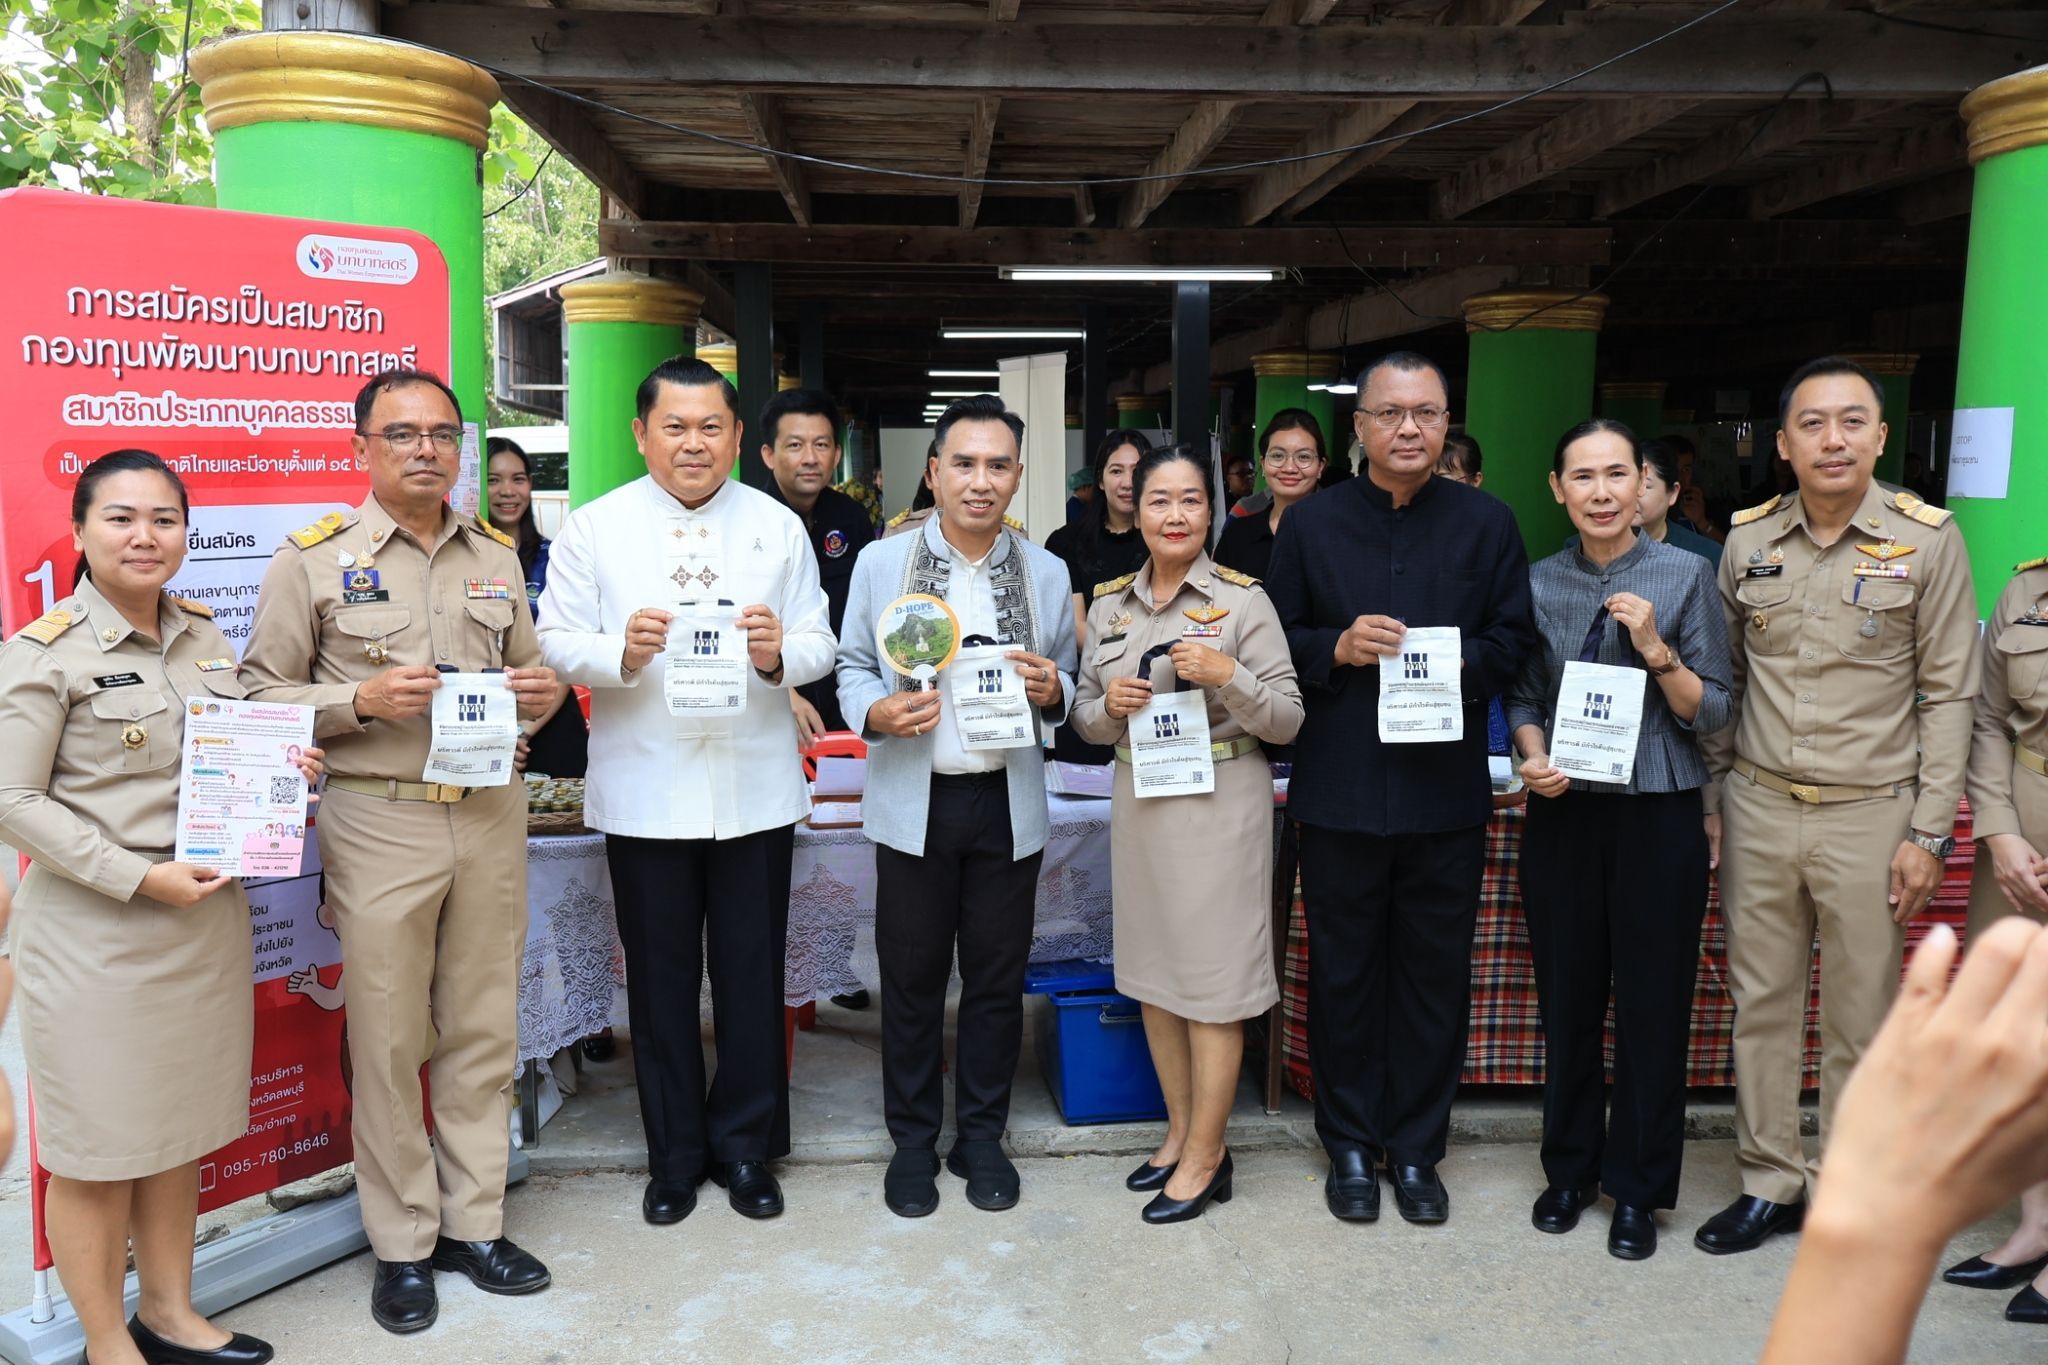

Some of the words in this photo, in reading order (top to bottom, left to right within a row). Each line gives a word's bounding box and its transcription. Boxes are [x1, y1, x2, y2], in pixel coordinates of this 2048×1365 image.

[337, 256, 407, 271] บทบาทสตรี
[66, 284, 383, 332] การสมัครเป็นสมาชิก
[21, 332, 417, 379] กองทุนพัฒนาบทบาทสตรี
[188, 528, 256, 550] ยื่นสมัคร
[25, 560, 55, 616] 1
[161, 585, 260, 601] ักงานเลขานุการ
[895, 602, 935, 615] D-HOPE
[1405, 662, 1427, 670] กทบ
[255, 936, 294, 955] ส่งไปยัง
[250, 1081, 305, 1107] งหวัดลพบุรี
[240, 1113, 297, 1138] หวัด/อำเภอ
[223, 1133, 330, 1178] 095-780-8646
